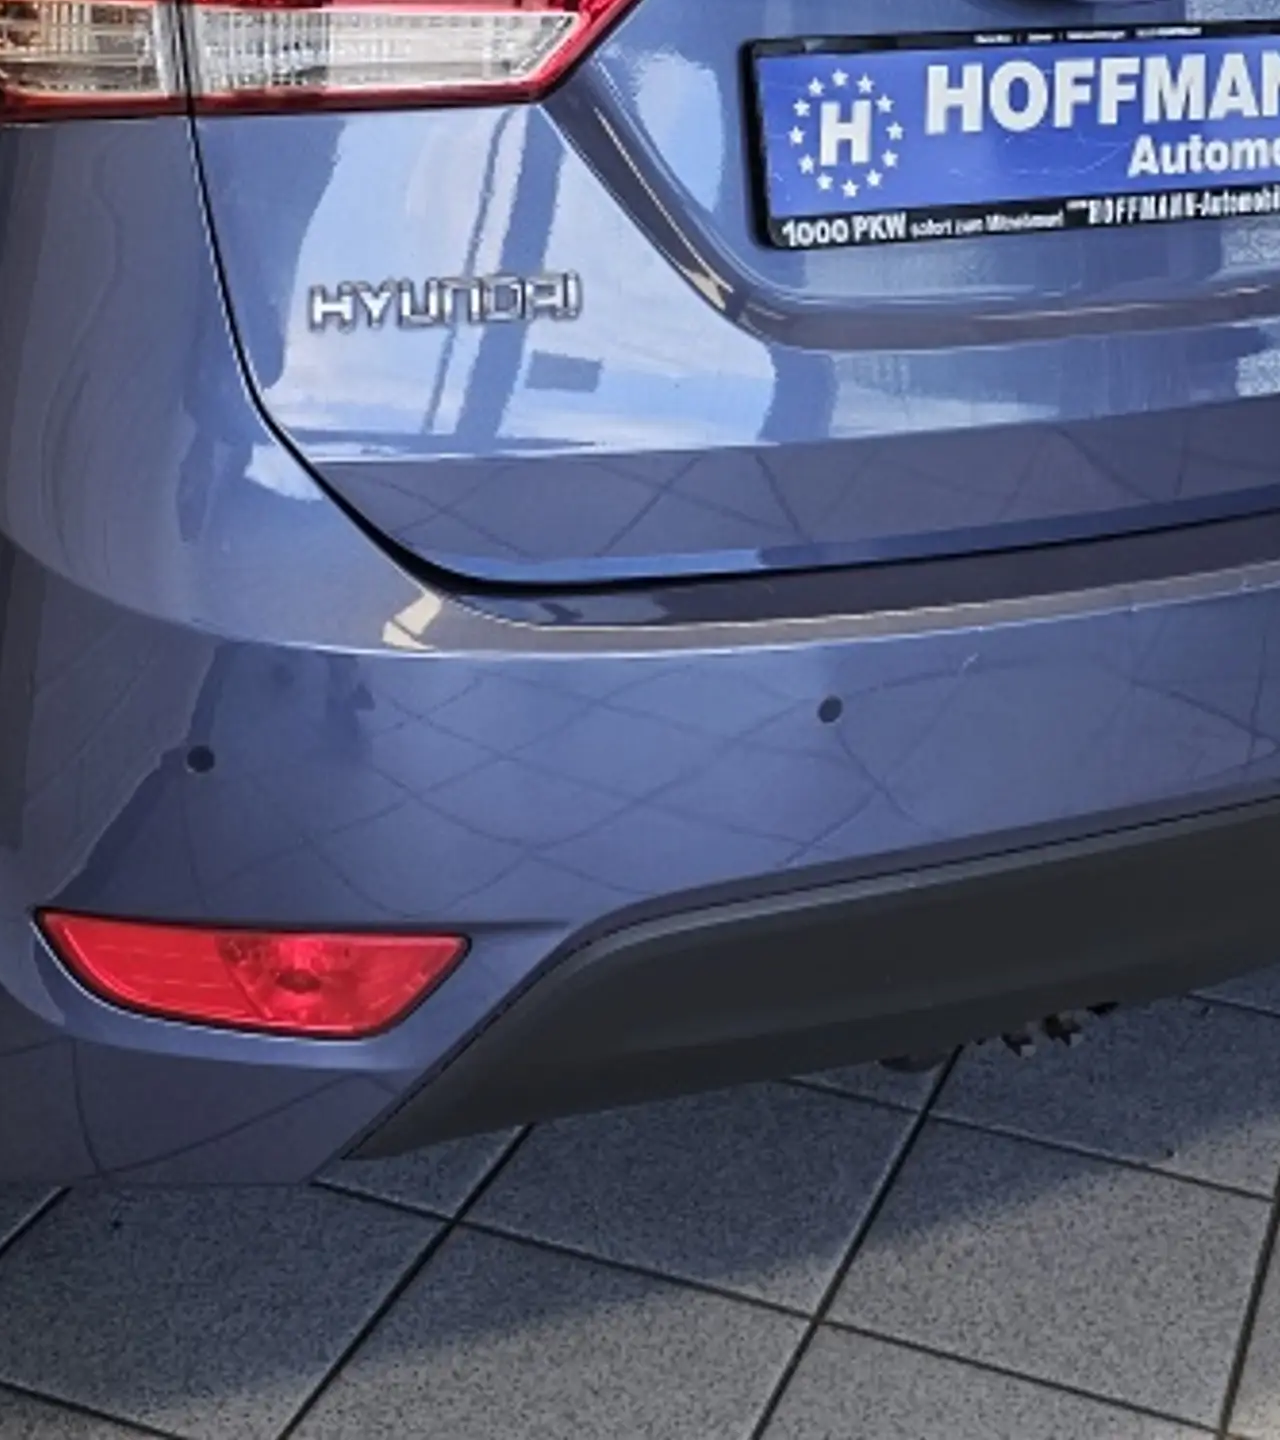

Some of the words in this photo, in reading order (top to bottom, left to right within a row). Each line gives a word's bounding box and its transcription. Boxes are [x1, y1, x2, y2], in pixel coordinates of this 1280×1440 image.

[819, 100, 872, 167] H
[781, 218, 848, 247] 1000
[852, 212, 907, 241] PKW
[308, 270, 583, 333] HYUNDAI
